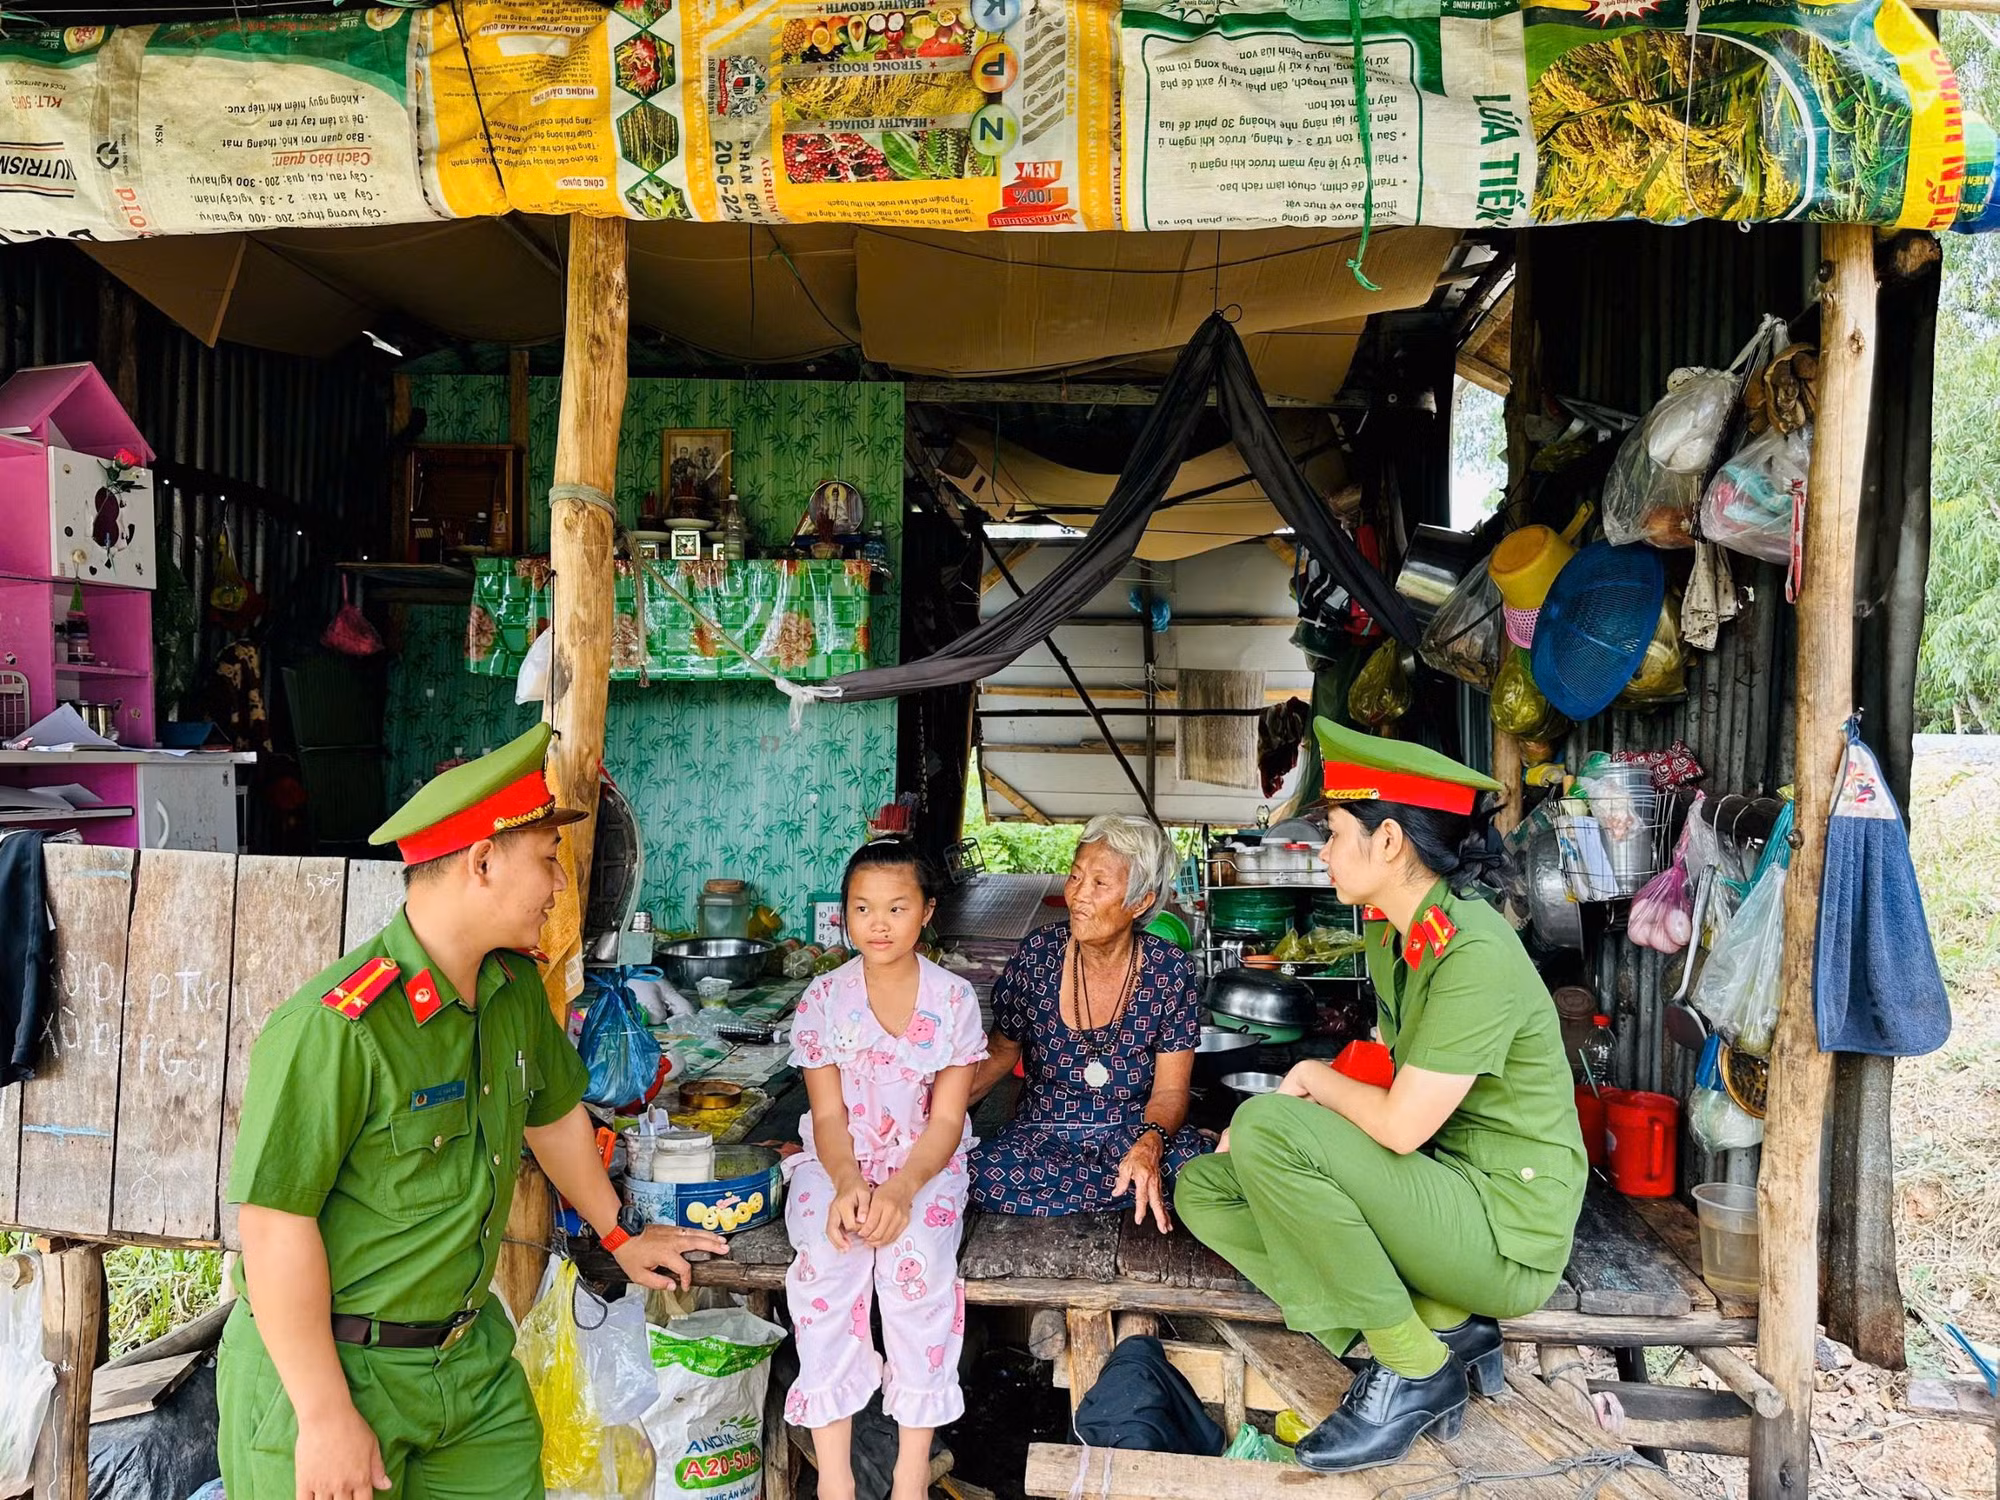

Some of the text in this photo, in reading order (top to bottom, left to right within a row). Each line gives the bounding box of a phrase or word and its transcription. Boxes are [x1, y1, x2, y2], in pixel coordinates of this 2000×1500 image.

[826, 0, 925, 13] HEALTHY GROWTH
[1260, 47, 1275, 58] lúa
[829, 60, 922, 74] STRONG ROOTS
[981, 53, 1005, 76] P
[1195, 59, 1219, 72] xong
[1067, 74, 1076, 89] OF
[1196, 78, 1214, 88] axit
[1291, 77, 1326, 89] hoạch,
[1330, 77, 1348, 86] thu
[34, 95, 62, 108] KLT:
[309, 96, 329, 106] nguy
[1066, 92, 1076, 115] USA
[224, 105, 245, 115] xúc.
[268, 103, 281, 112] khi
[301, 117, 316, 126] tay
[339, 115, 348, 124] xa
[1332, 115, 1345, 126] lại
[1377, 112, 1397, 123] nên
[828, 118, 927, 130] HEALTHY FOLIAGE
[980, 117, 1004, 141] N
[1159, 120, 1175, 132] lúa
[1195, 118, 1218, 131] phút
[1221, 118, 1234, 129] 30
[155, 125, 163, 147] NSX:
[1169, 135, 1196, 148] ngâm
[1200, 136, 1215, 147] khi
[1218, 134, 1246, 146] trước
[1251, 133, 1283, 146] tháng,
[1286, 137, 1293, 146] 4
[1306, 137, 1312, 146] 3
[1377, 130, 1397, 142] Sau
[337, 152, 370, 166] Cách
[740, 141, 753, 184] PHÂN
[1199, 158, 1228, 171] ngâm
[1230, 159, 1245, 170] khi
[1248, 158, 1276, 170] trước
[1329, 158, 1338, 169] lệ
[1020, 161, 1056, 178] NEW
[236, 177, 256, 187] 300
[265, 176, 280, 185] 200
[350, 171, 367, 184] Cây
[760, 157, 777, 213] AGRIUM
[1216, 183, 1238, 193] bao.
[1241, 182, 1263, 192] rách
[1266, 180, 1285, 191] làm
[1319, 181, 1348, 193] chim,
[259, 195, 275, 205] 3.5
[287, 194, 294, 204] 2
[355, 189, 373, 200] Cây
[1013, 189, 1053, 205] 100%
[248, 213, 266, 222] 400
[275, 213, 294, 222] 200
[362, 207, 380, 218] Cây
